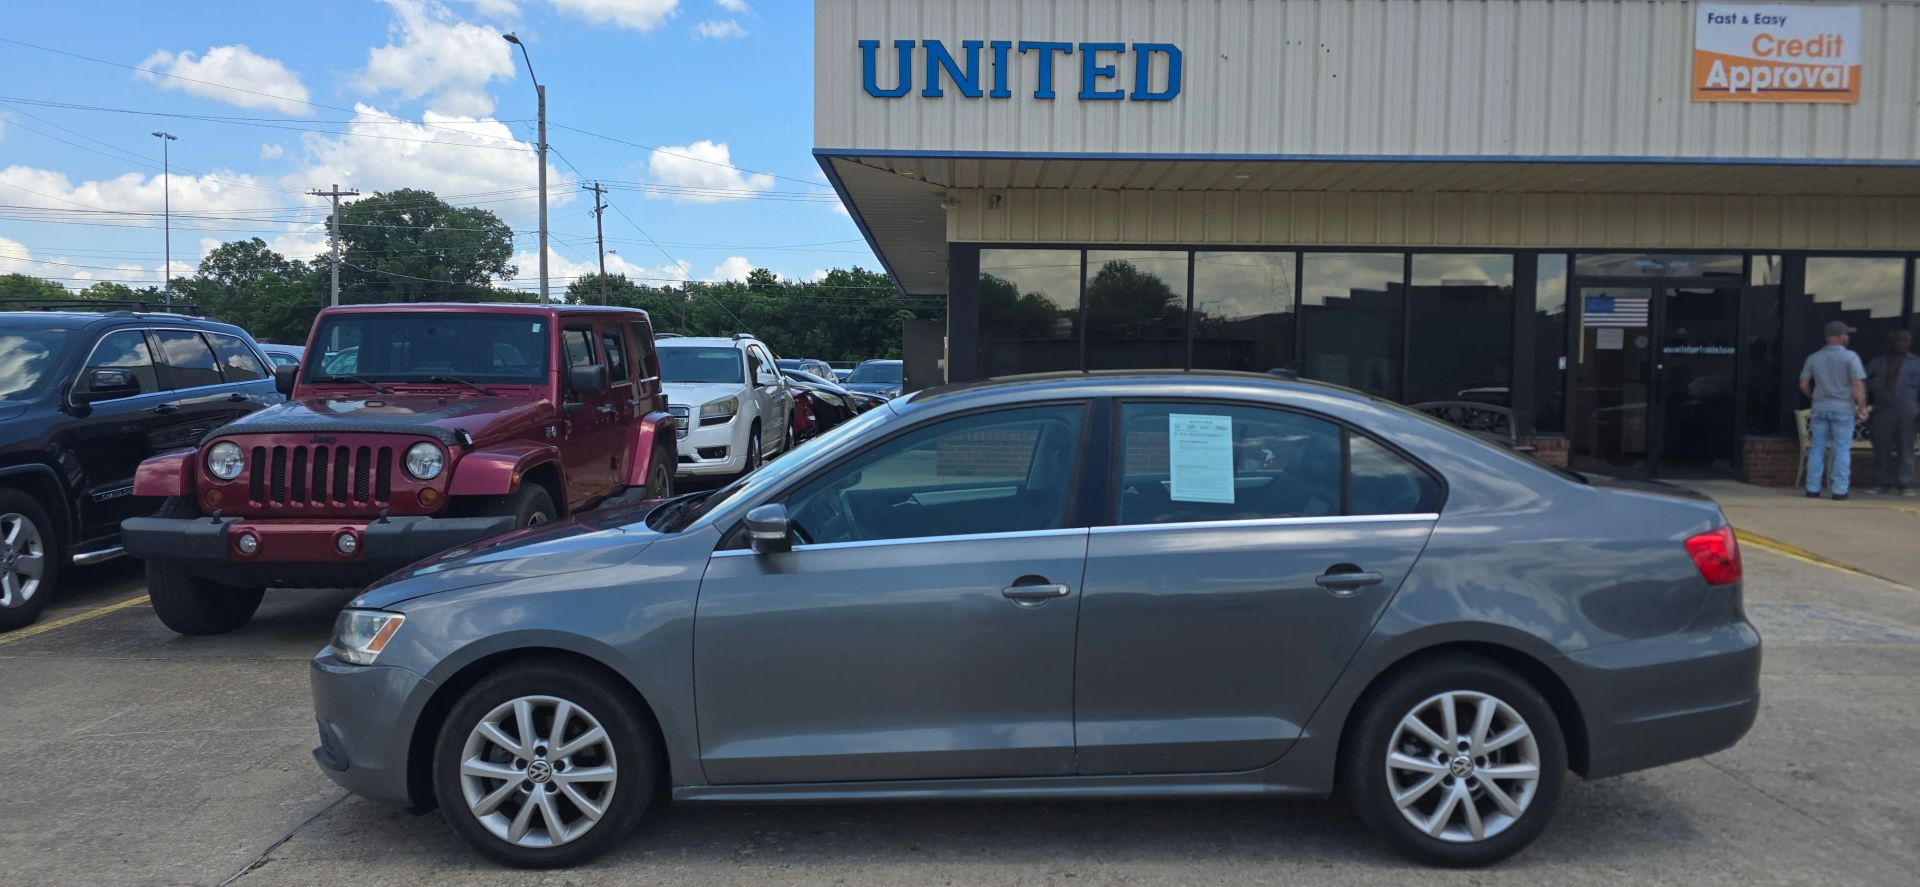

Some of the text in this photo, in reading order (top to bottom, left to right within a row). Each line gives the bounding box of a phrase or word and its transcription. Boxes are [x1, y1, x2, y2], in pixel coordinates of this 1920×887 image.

[1707, 12, 1787, 27] Fast & Easy
[1751, 32, 1843, 58] Credit
[858, 39, 1182, 101] UNITED
[1705, 59, 1849, 94] Approval
